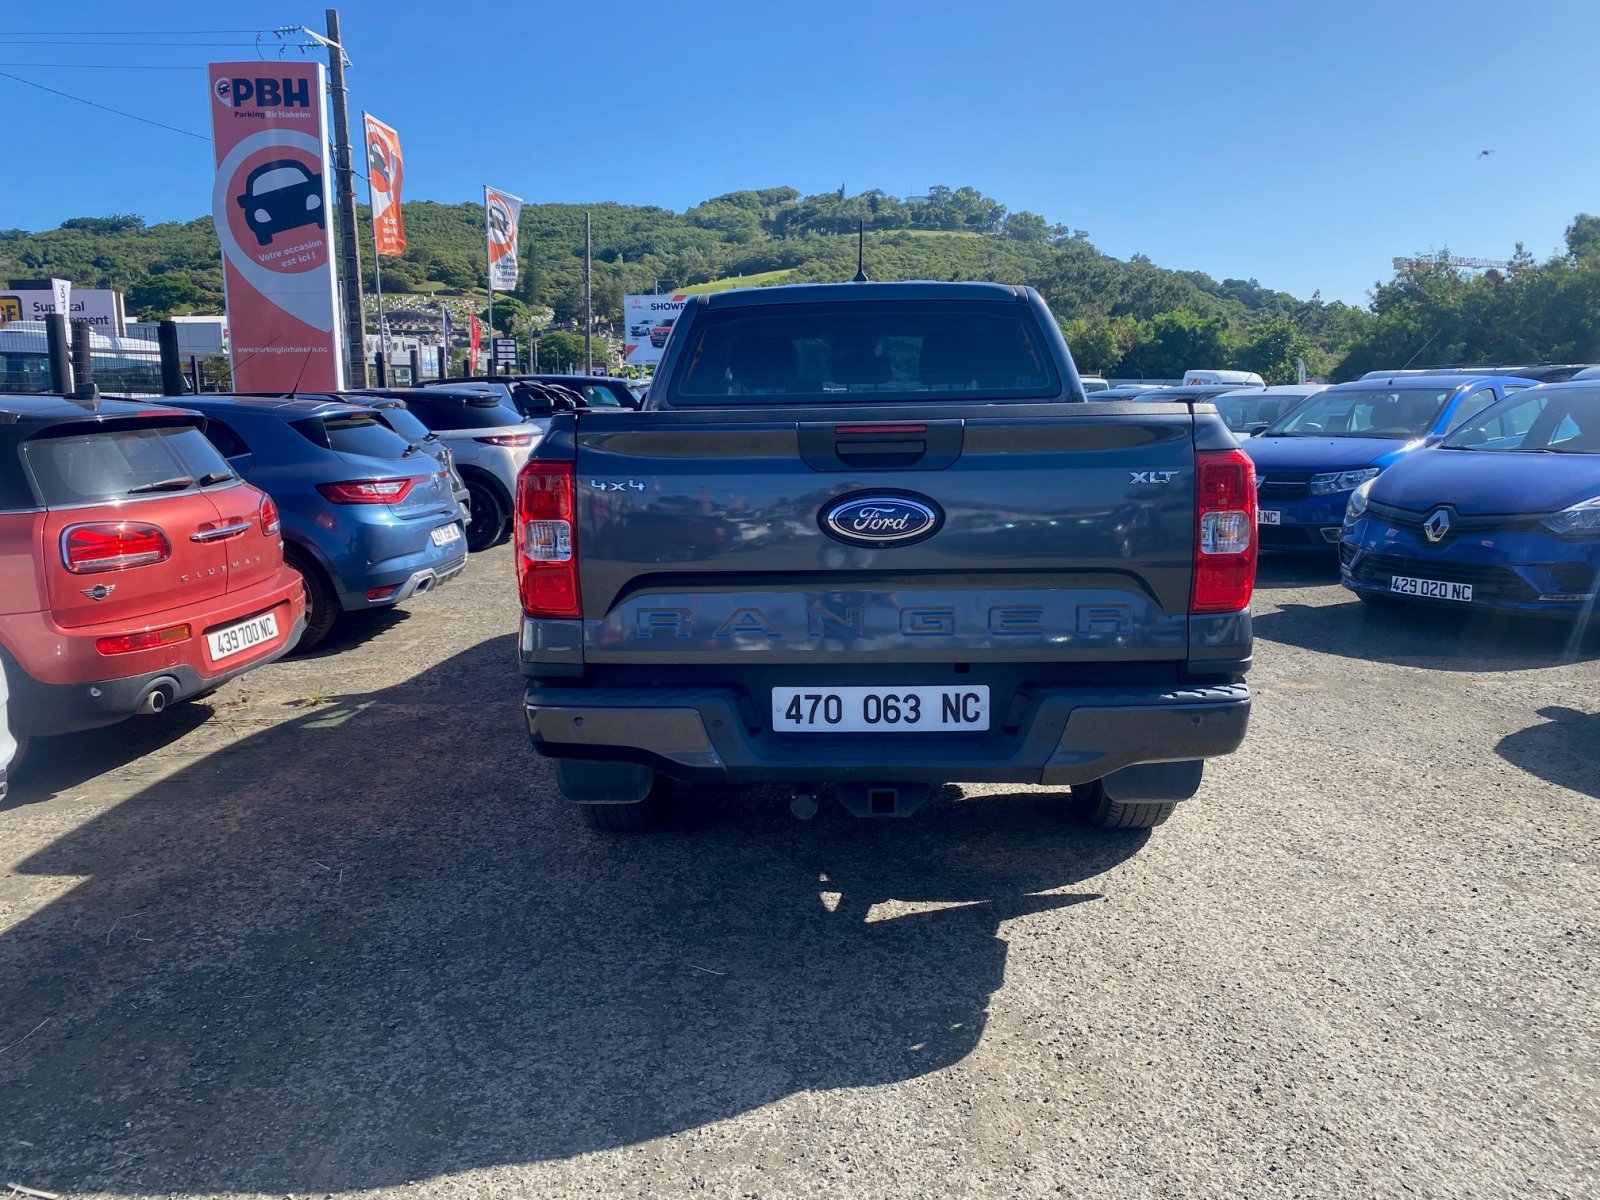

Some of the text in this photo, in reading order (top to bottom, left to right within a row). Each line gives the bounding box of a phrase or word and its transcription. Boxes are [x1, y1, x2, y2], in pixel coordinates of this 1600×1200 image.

[232, 78, 310, 107] PBH
[259, 240, 323, 262] Votre occasion
[281, 257, 297, 267] est
[299, 253, 311, 262] ici
[590, 479, 646, 492] 4x4
[1129, 470, 1181, 484] XLT
[853, 507, 910, 530] Ford
[1263, 512, 1277, 523] NC
[181, 555, 261, 582] CLUBMAN
[1393, 577, 1471, 600] 429 020 NC
[636, 604, 1135, 639] RANGER
[218, 617, 274, 654] 439 700 NC
[785, 693, 981, 724] 470 063 NC
